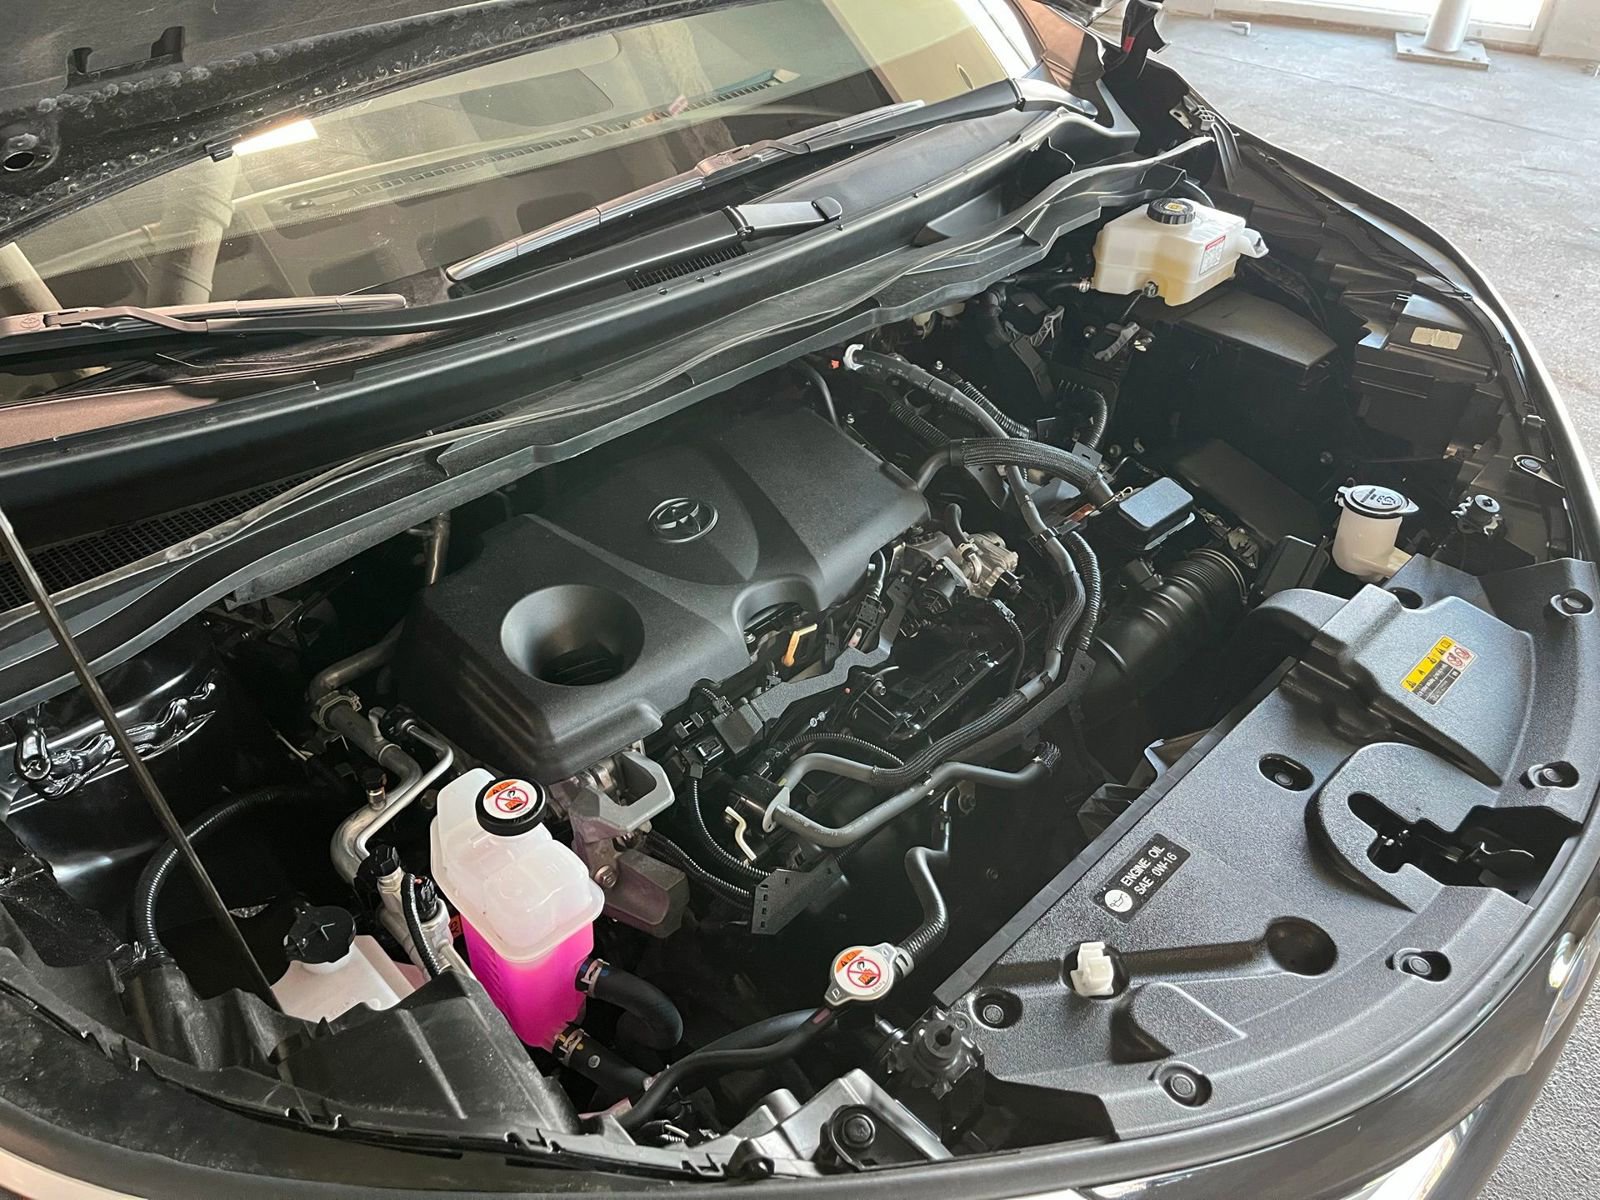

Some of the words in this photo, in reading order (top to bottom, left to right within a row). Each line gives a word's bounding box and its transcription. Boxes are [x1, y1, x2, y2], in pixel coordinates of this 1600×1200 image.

[1120, 857, 1151, 887] ENGINE
[1148, 845, 1165, 858] OIL
[1134, 876, 1154, 895] SAE
[1151, 852, 1177, 877] 0W-16
